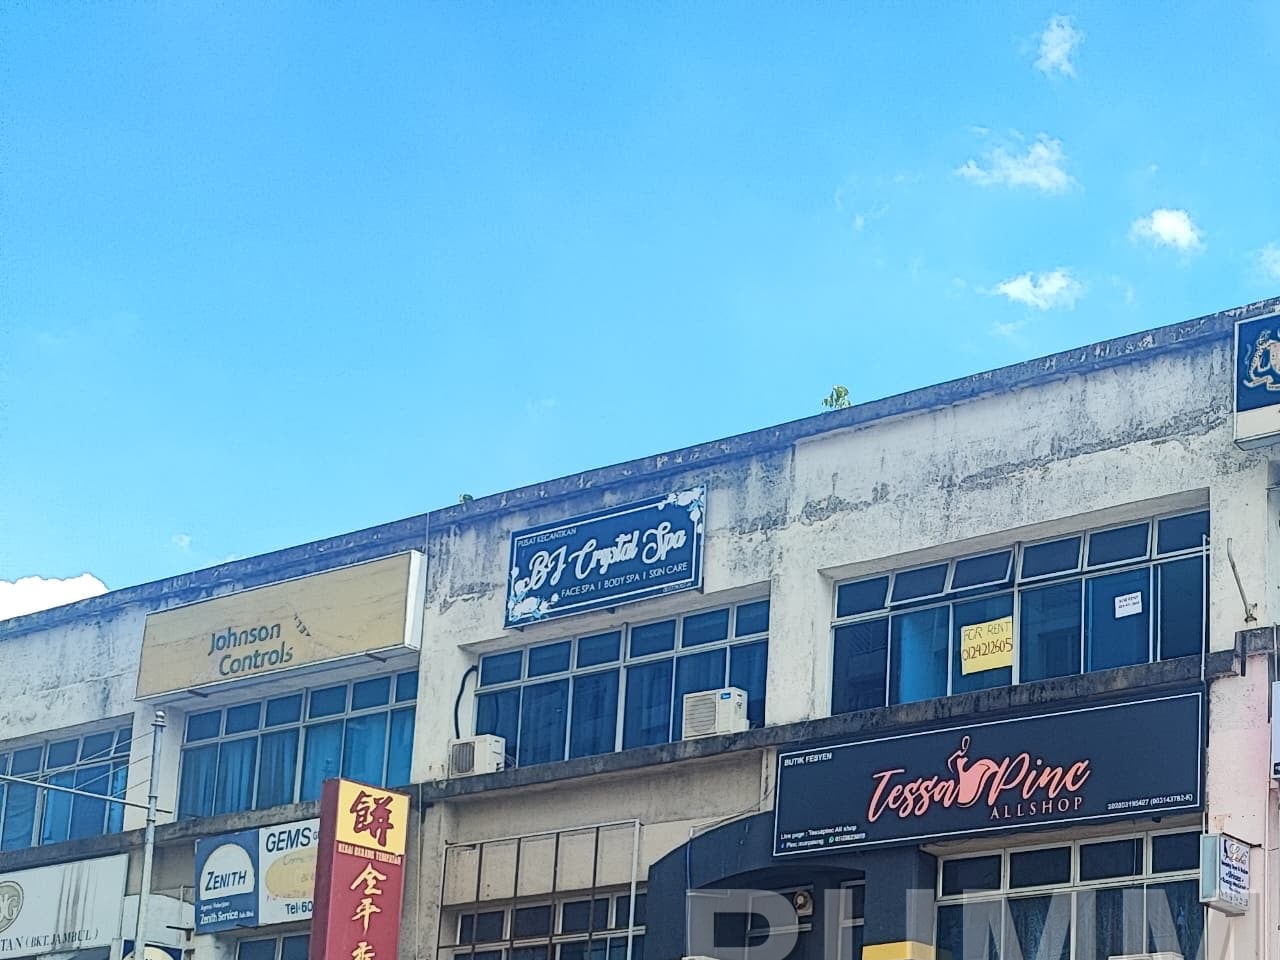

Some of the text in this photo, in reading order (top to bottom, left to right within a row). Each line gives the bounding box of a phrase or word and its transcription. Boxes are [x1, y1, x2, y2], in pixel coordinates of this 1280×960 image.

[518, 537, 536, 547] PUSAT
[568, 530, 640, 580] Crystal
[642, 521, 687, 564] Spa
[561, 562, 688, 599] FACE SPA BODY SPA SKIN CARE
[208, 623, 281, 656] Johnson
[963, 621, 1012, 642] FOR RENT
[219, 642, 294, 676] Controls
[784, 755, 805, 766] BUTIK
[867, 752, 1090, 823] Tessa Pinc
[350, 790, 394, 847] 餅
[990, 796, 1083, 820] ALLSHOP
[265, 827, 312, 853] GEMS
[205, 870, 247, 892] ZENITH
[200, 910, 217, 924] Zenith
[217, 907, 239, 922] Service
